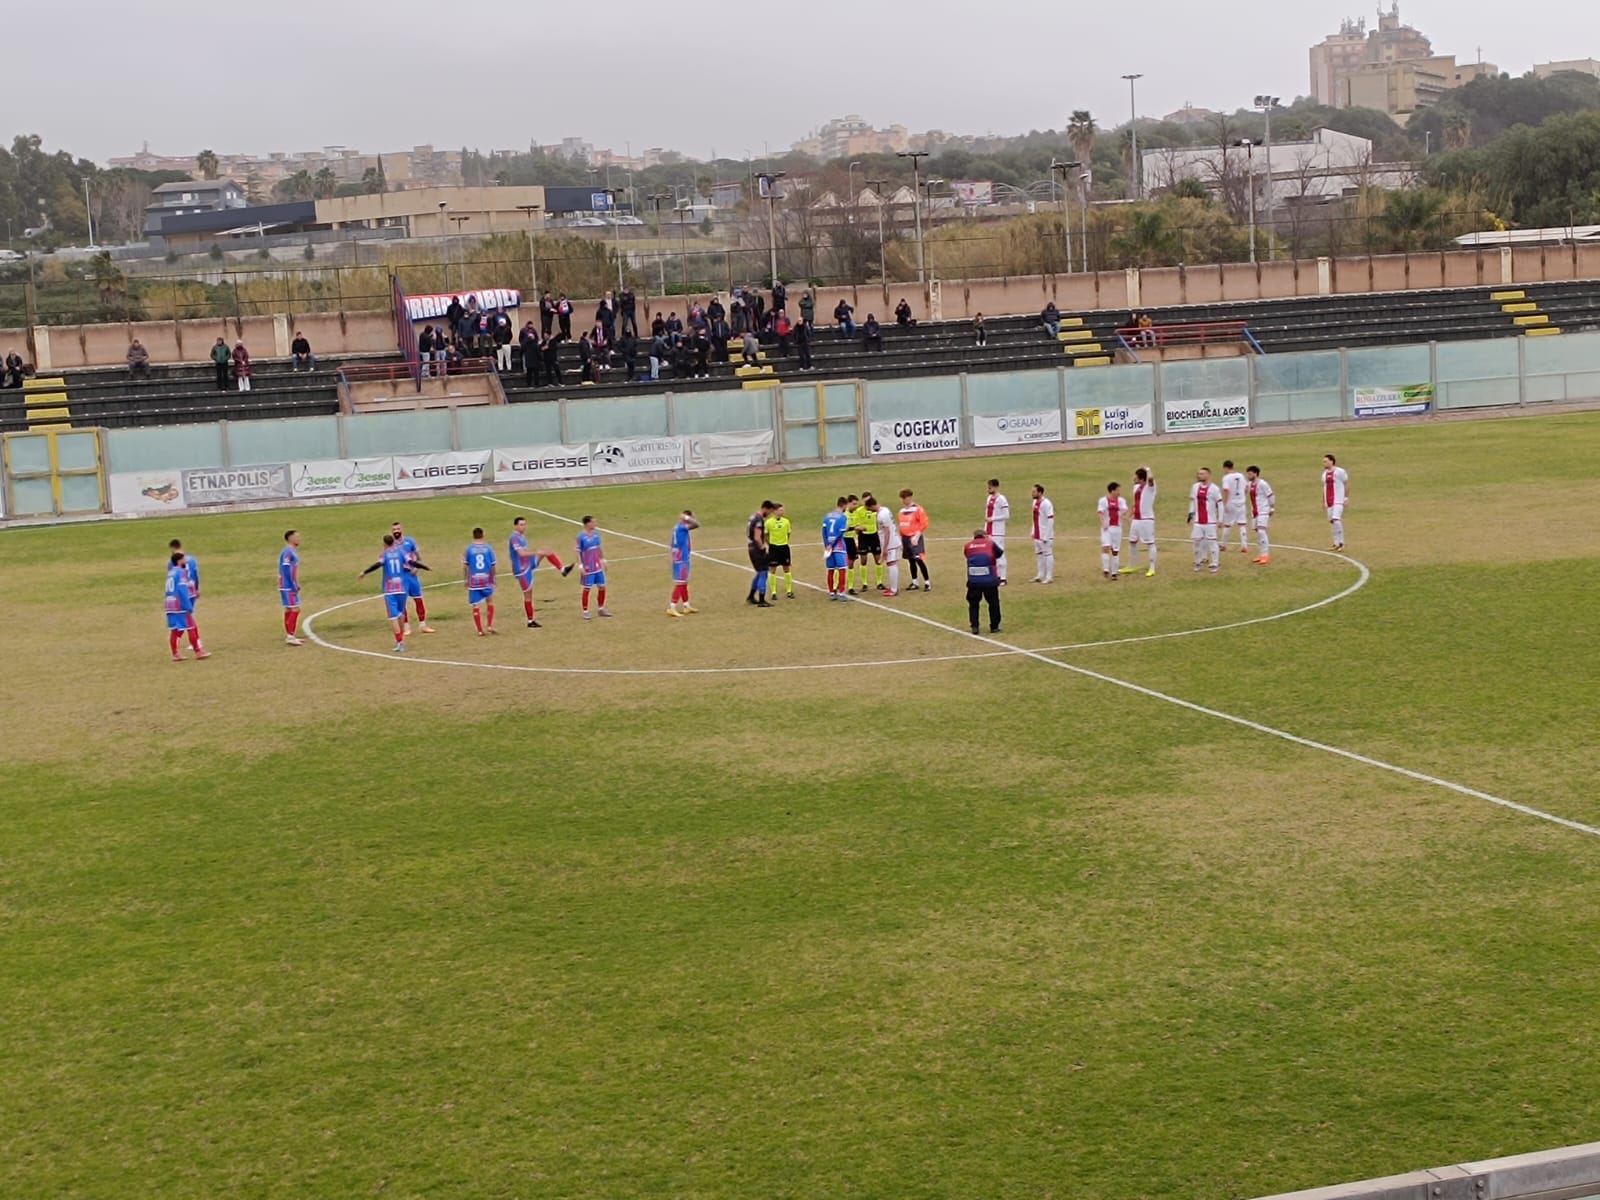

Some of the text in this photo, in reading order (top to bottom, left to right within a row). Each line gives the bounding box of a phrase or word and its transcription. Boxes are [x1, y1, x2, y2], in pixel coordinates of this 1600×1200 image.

[1104, 408, 1129, 420] Luigi
[1166, 406, 1246, 420] BIOCHEMICAL AGRO
[894, 419, 957, 438] COGEKAT
[1009, 418, 1042, 428] GEALAN
[1104, 420, 1143, 431] Floridia
[896, 439, 959, 451] distributori
[512, 456, 588, 471] CIBIESSE
[189, 471, 269, 490] ETNAPOLIS
[829, 519, 836, 532] 7
[390, 559, 400, 573] 11
[476, 554, 484, 569] 8
